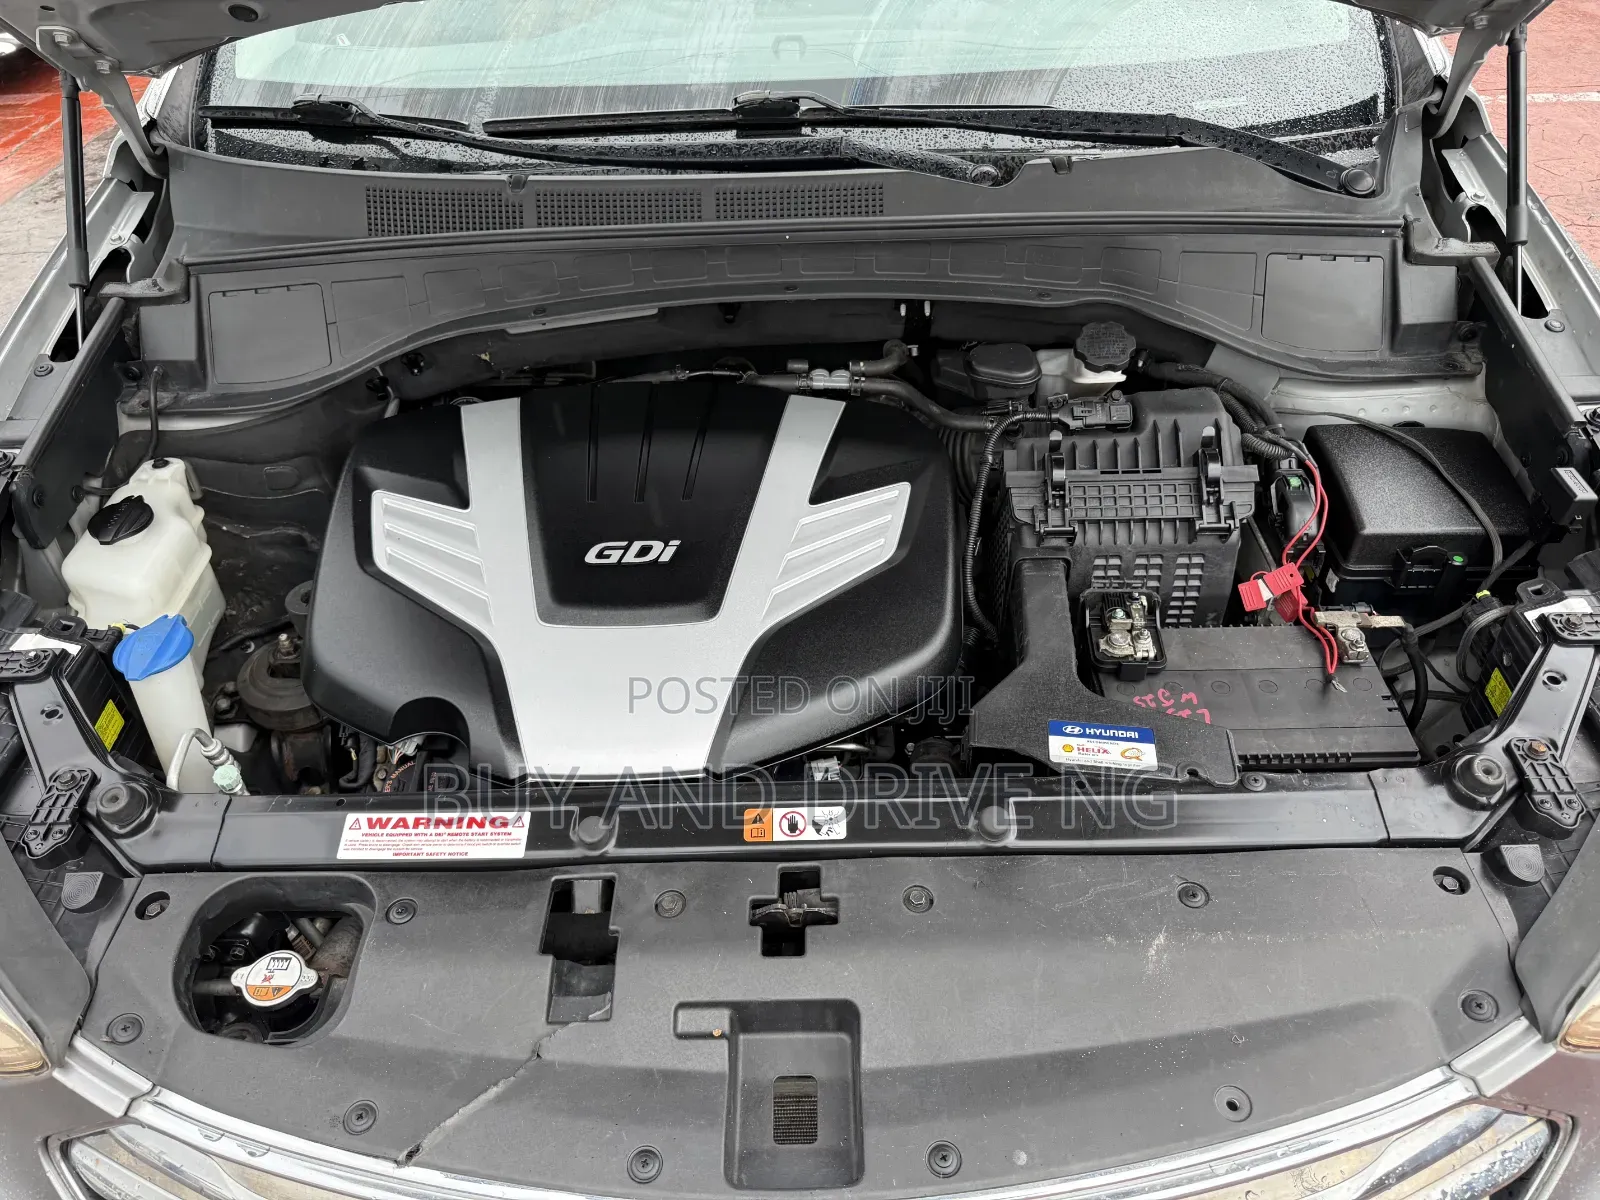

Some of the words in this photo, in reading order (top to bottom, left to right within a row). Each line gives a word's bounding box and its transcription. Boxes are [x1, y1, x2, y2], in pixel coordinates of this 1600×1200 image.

[584, 539, 682, 565] GDi
[1085, 727, 1139, 739] HYUNDAI
[1077, 746, 1110, 755] HELIX
[390, 761, 416, 779] MANUAL
[367, 816, 510, 830] WARNING
